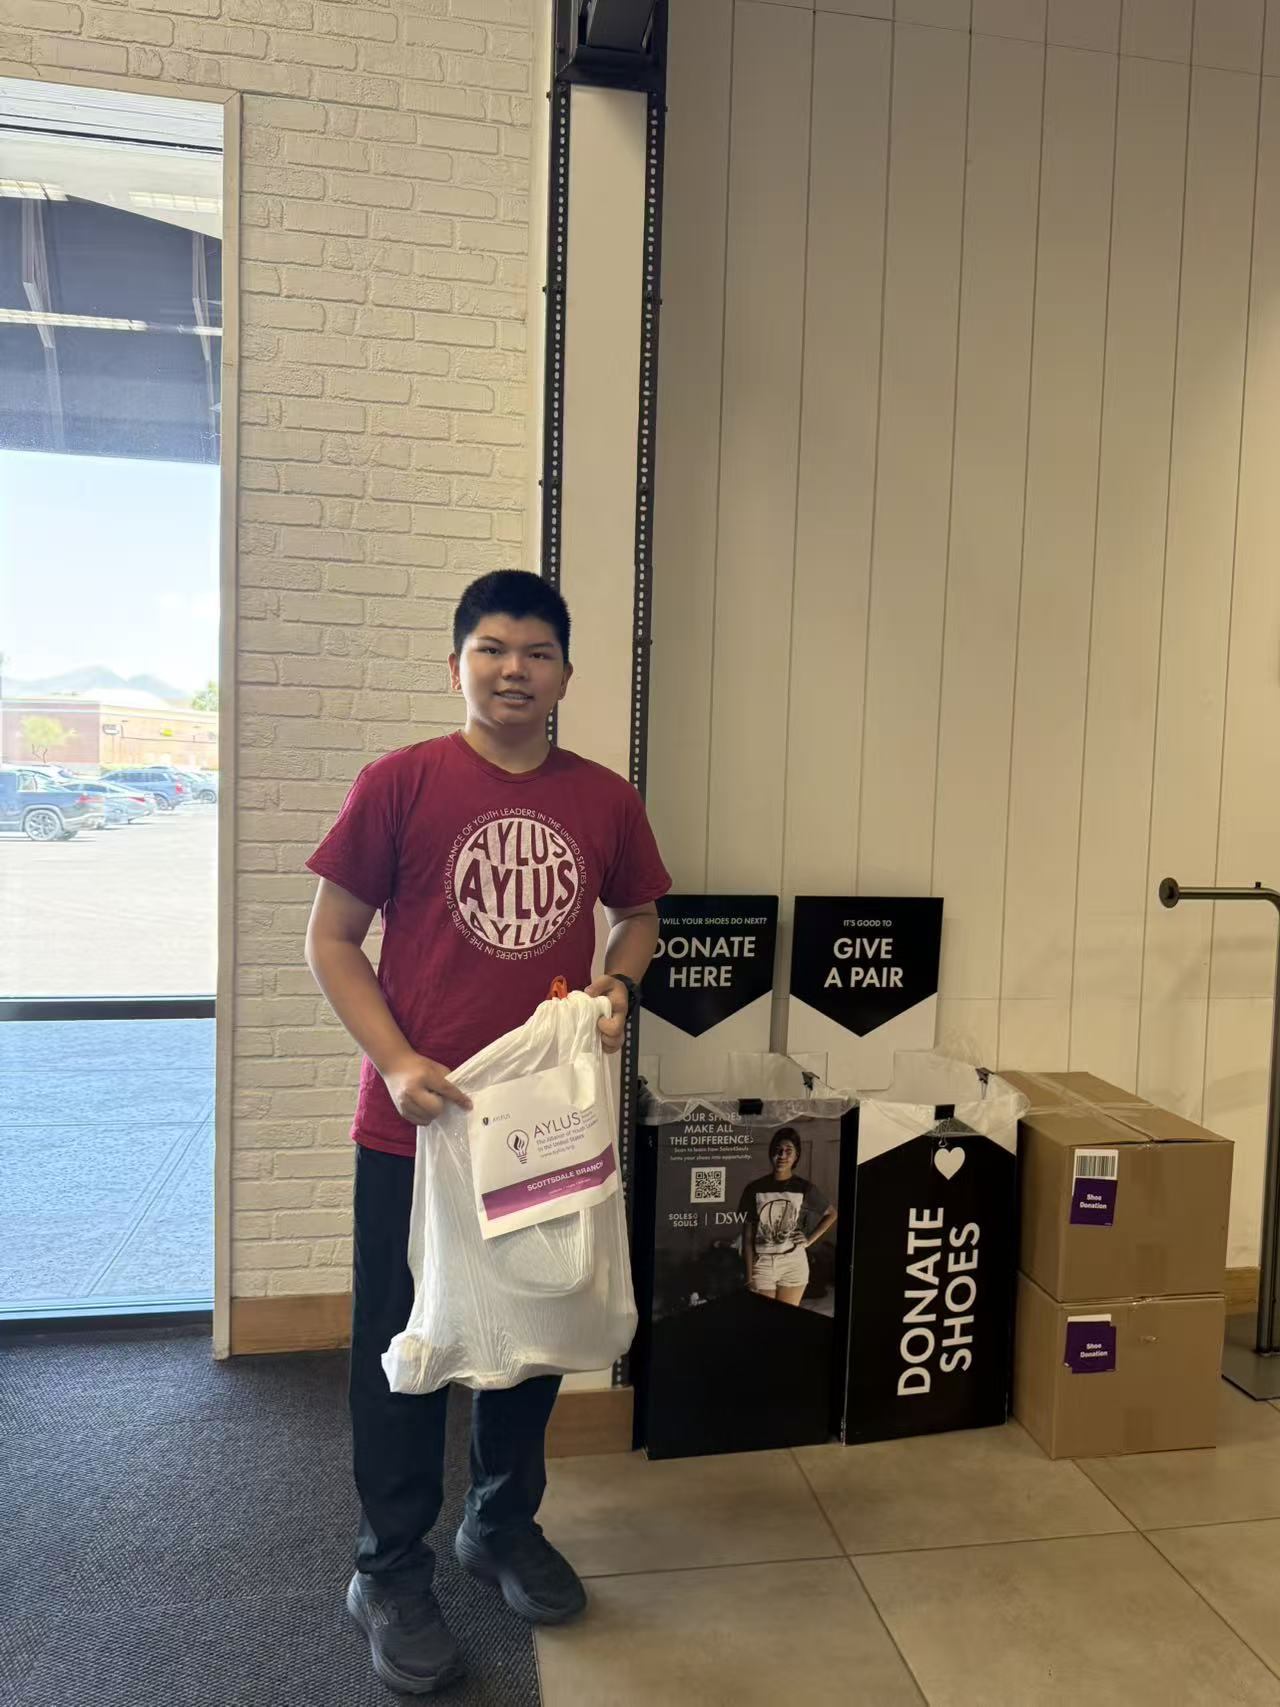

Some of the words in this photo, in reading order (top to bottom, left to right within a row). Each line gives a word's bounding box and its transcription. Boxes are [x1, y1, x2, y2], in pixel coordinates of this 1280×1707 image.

[446, 835, 465, 877] ALLIANCE
[462, 822, 474, 835] OF
[473, 809, 499, 826] YOUTH
[500, 808, 536, 818] LEADERS
[537, 812, 546, 821] IN
[547, 817, 560, 830] THE
[560, 828, 580, 854] UNITED
[576, 856, 587, 885] STATES
[467, 821, 567, 866] AYLUS
[459, 859, 575, 920] AYLUS
[451, 911, 471, 939] UNITED
[744, 917, 768, 925] NEXT?
[843, 919, 856, 927] IT'S
[857, 919, 881, 927] GOOD
[882, 919, 892, 927] TO
[470, 911, 566, 947] AYLUS
[556, 927, 566, 940] OF
[469, 936, 485, 951] THE
[485, 945, 495, 955] IN
[533, 938, 557, 956] YOUTH
[653, 936, 756, 959] DONATE
[833, 937, 894, 960] GIVE
[496, 949, 532, 961] LEADERS
[669, 966, 733, 988] HERE
[823, 967, 843, 989] A
[850, 967, 904, 989] PAIR
[683, 1112, 705, 1122] OUR
[533, 1111, 581, 1139] AYLUS
[684, 1124, 714, 1134] MAKE
[716, 1123, 734, 1133] ALL
[669, 1136, 688, 1146] THE
[527, 1170, 575, 1192] SCOTTSDALE
[1086, 1193, 1102, 1201] Shoe
[1079, 1201, 1107, 1210] Donation
[673, 1220, 698, 1228] SOULS
[715, 1211, 748, 1225] DSW
[897, 1207, 944, 1396] DONATE
[940, 1222, 980, 1373] SHOES
[1080, 1350, 1108, 1359] Donation
[1086, 1343, 1102, 1351] Shoe
